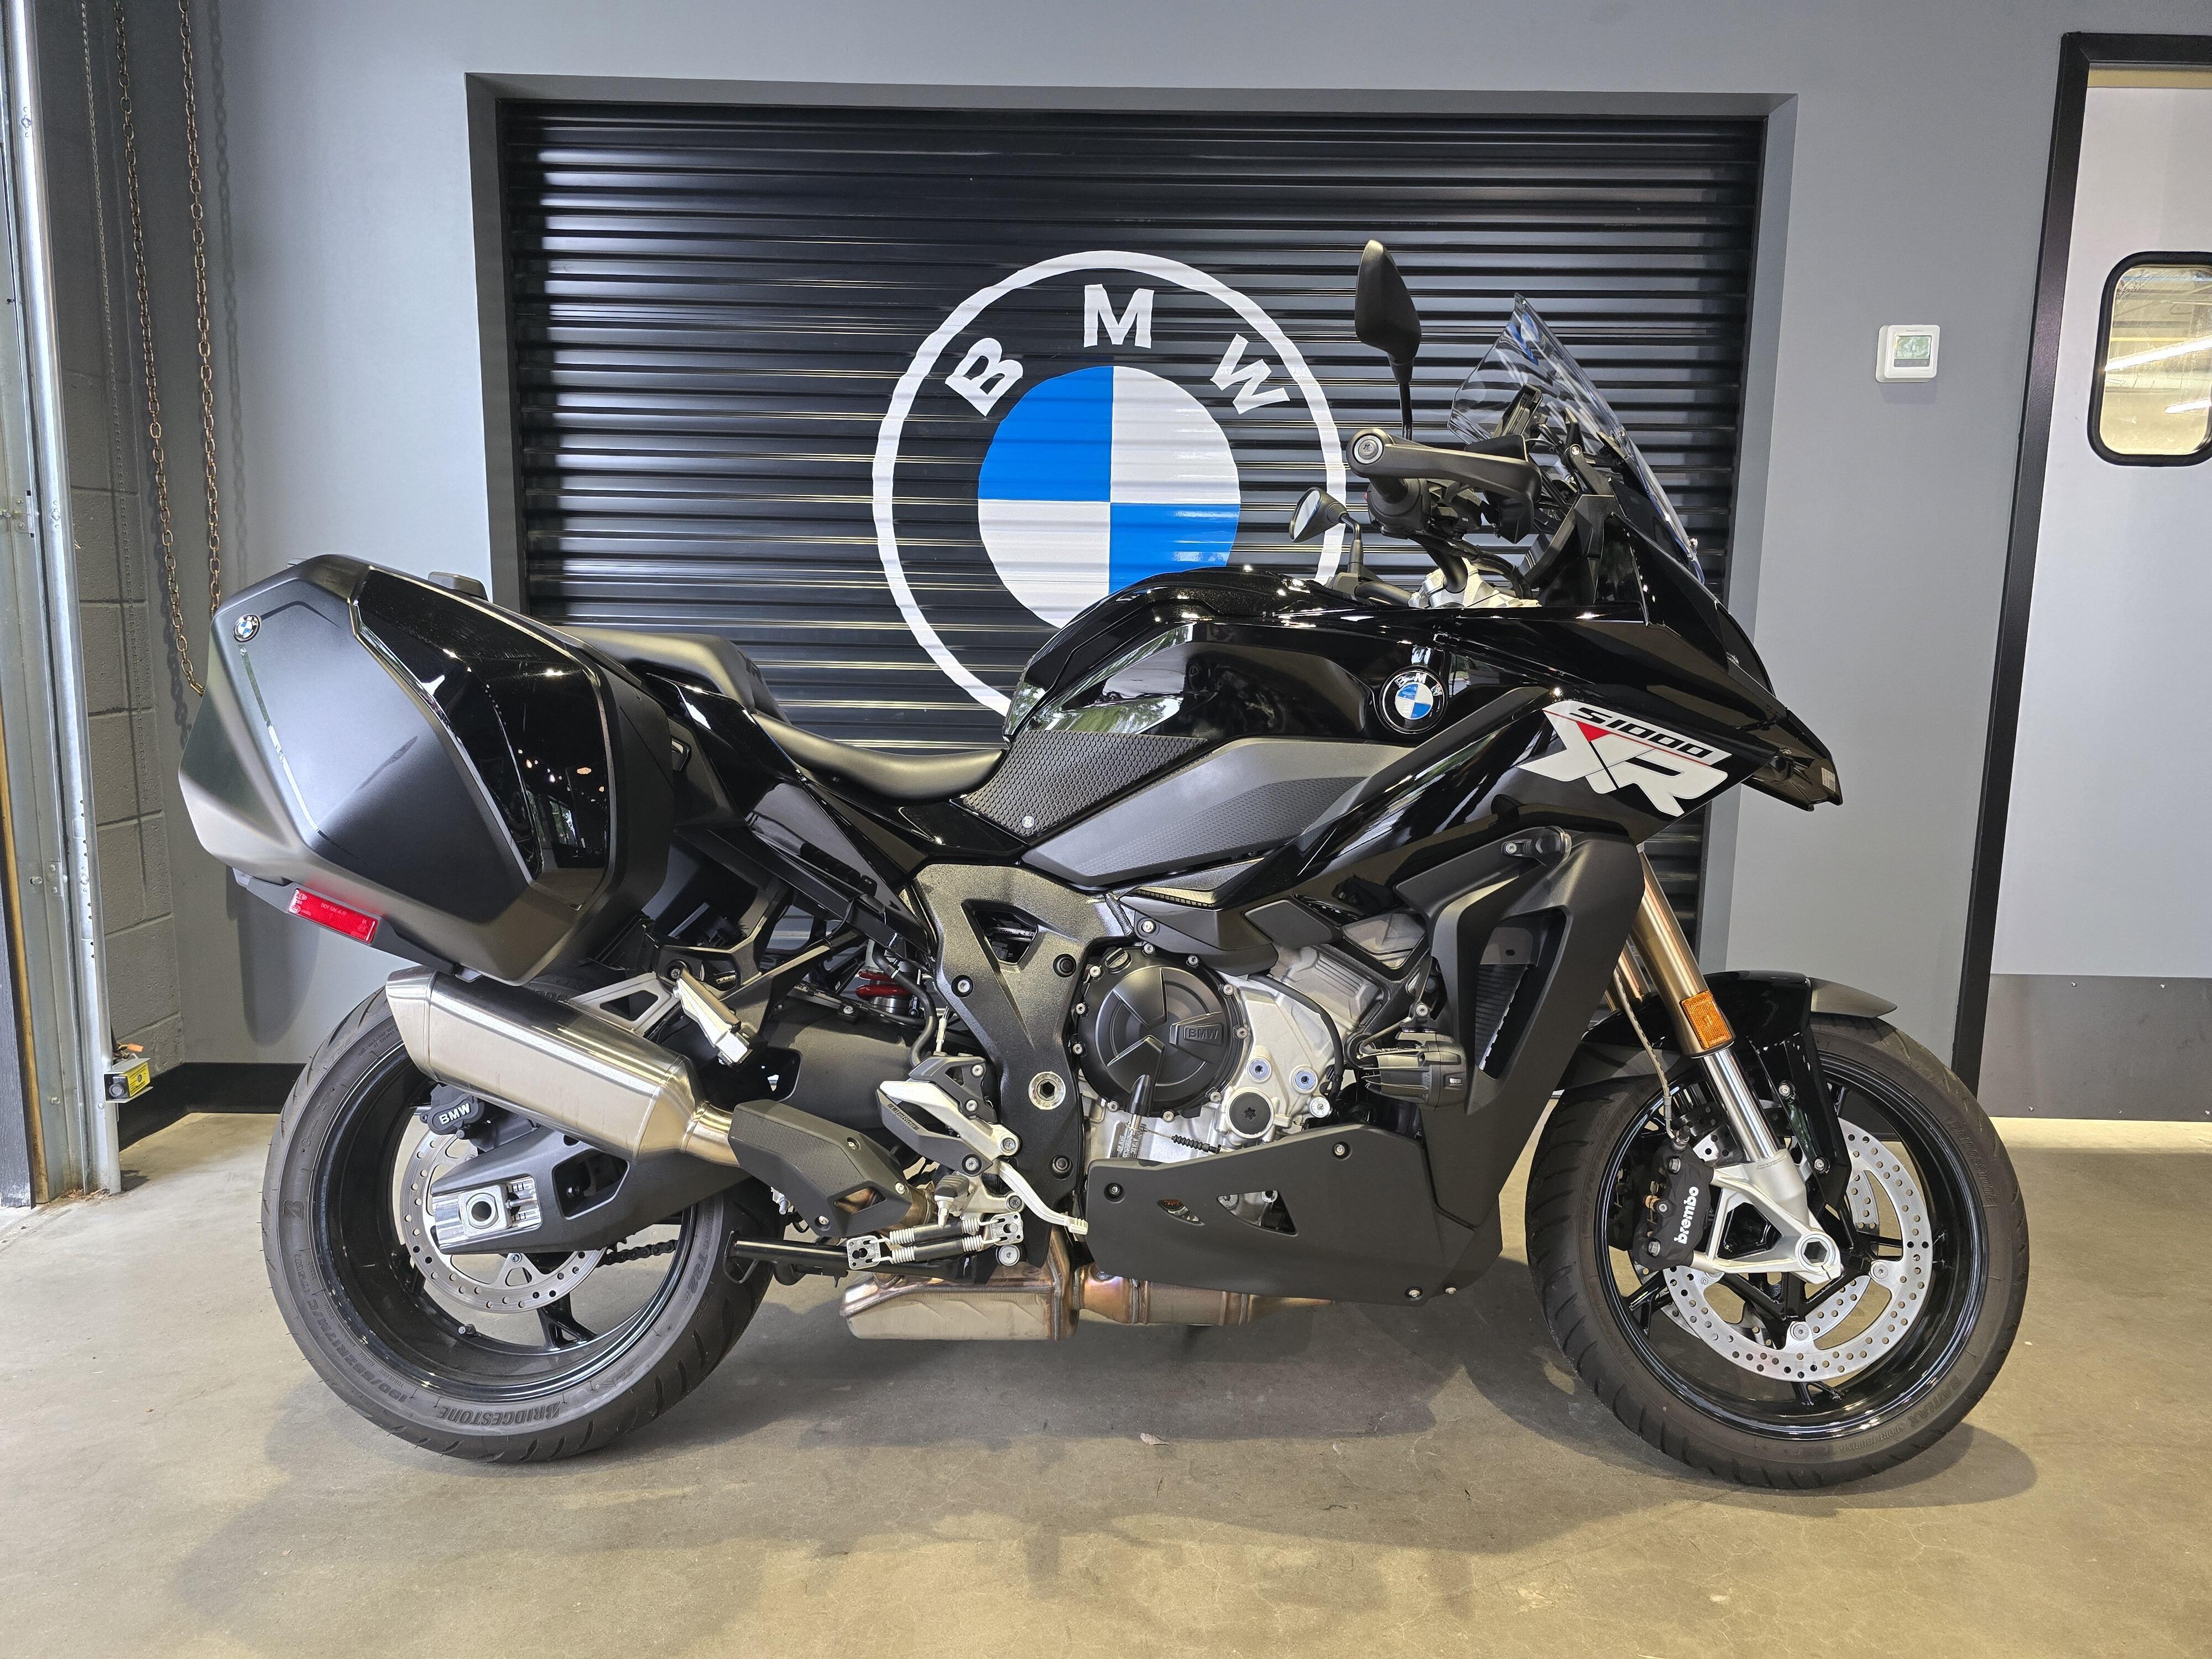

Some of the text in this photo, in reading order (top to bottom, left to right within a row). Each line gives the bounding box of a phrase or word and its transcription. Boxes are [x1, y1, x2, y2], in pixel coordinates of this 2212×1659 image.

[945, 284, 1291, 417] BMW
[1394, 671, 1443, 696] BMW
[1568, 707, 1714, 759] S1000
[1189, 1029, 1219, 1040] BMW
[439, 1103, 470, 1125] BMW
[1673, 1186, 1699, 1244] brembo
[435, 1401, 561, 1426] BRIDGESTONE
